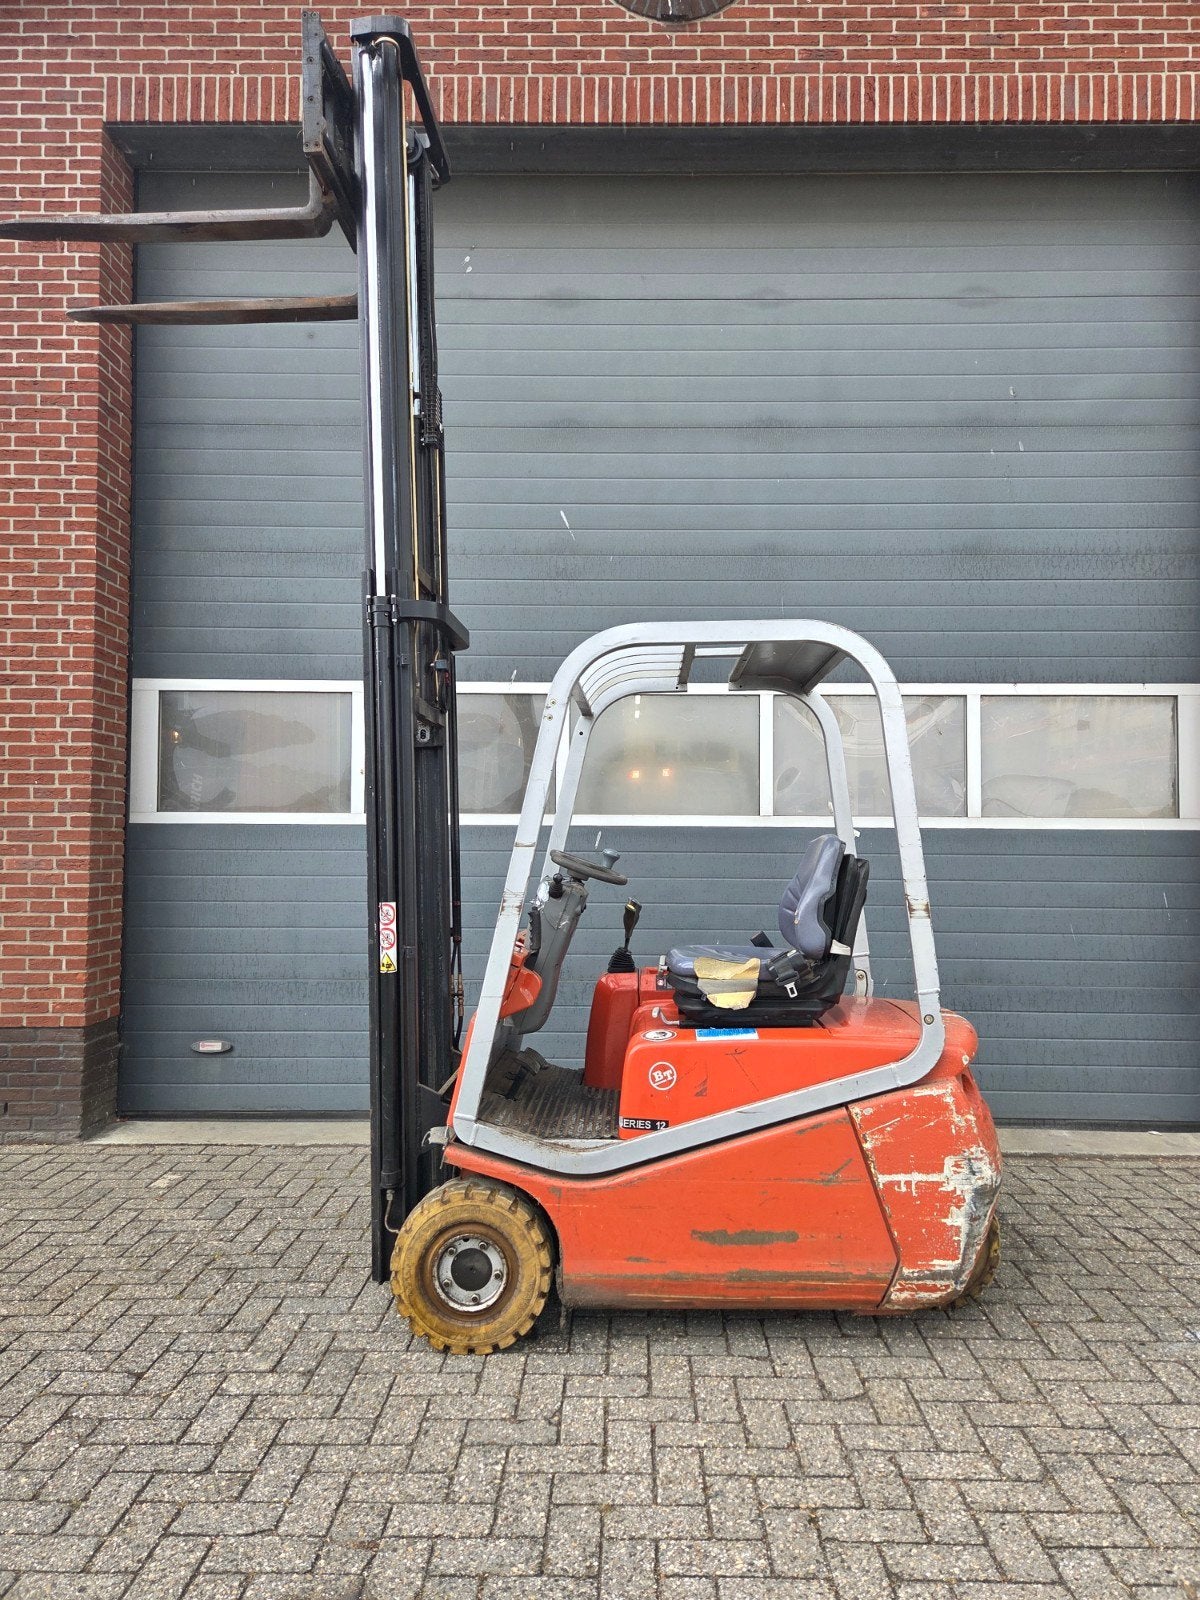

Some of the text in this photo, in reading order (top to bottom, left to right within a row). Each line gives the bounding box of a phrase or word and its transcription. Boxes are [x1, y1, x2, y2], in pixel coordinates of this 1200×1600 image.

[652, 1069, 674, 1082] BT
[622, 1118, 666, 1130] ERIES 12
